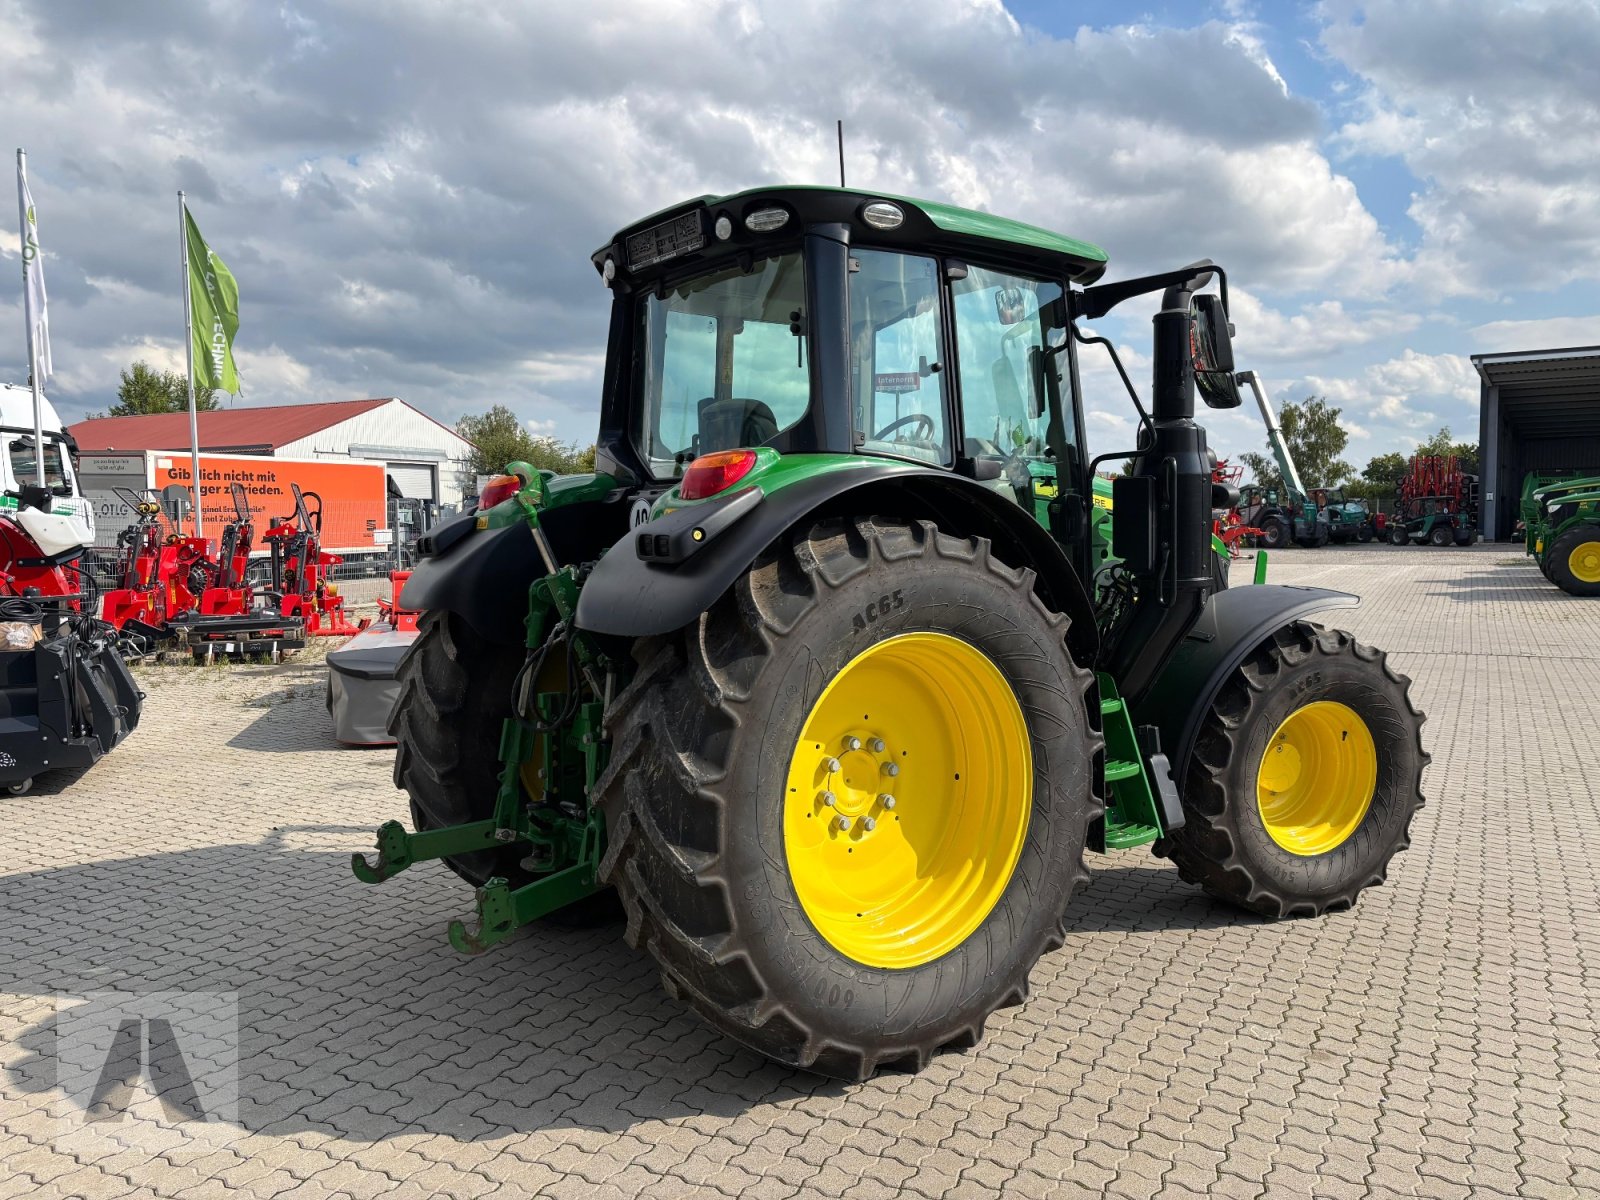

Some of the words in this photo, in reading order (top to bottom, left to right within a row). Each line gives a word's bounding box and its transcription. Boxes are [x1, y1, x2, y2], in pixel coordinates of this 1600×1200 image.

[168, 468, 191, 480] Gib
[224, 470, 255, 482] nicht
[257, 471, 276, 482] mit
[224, 483, 284, 495] zrieden.
[101, 503, 128, 516] OTLG
[853, 589, 904, 635] AC65
